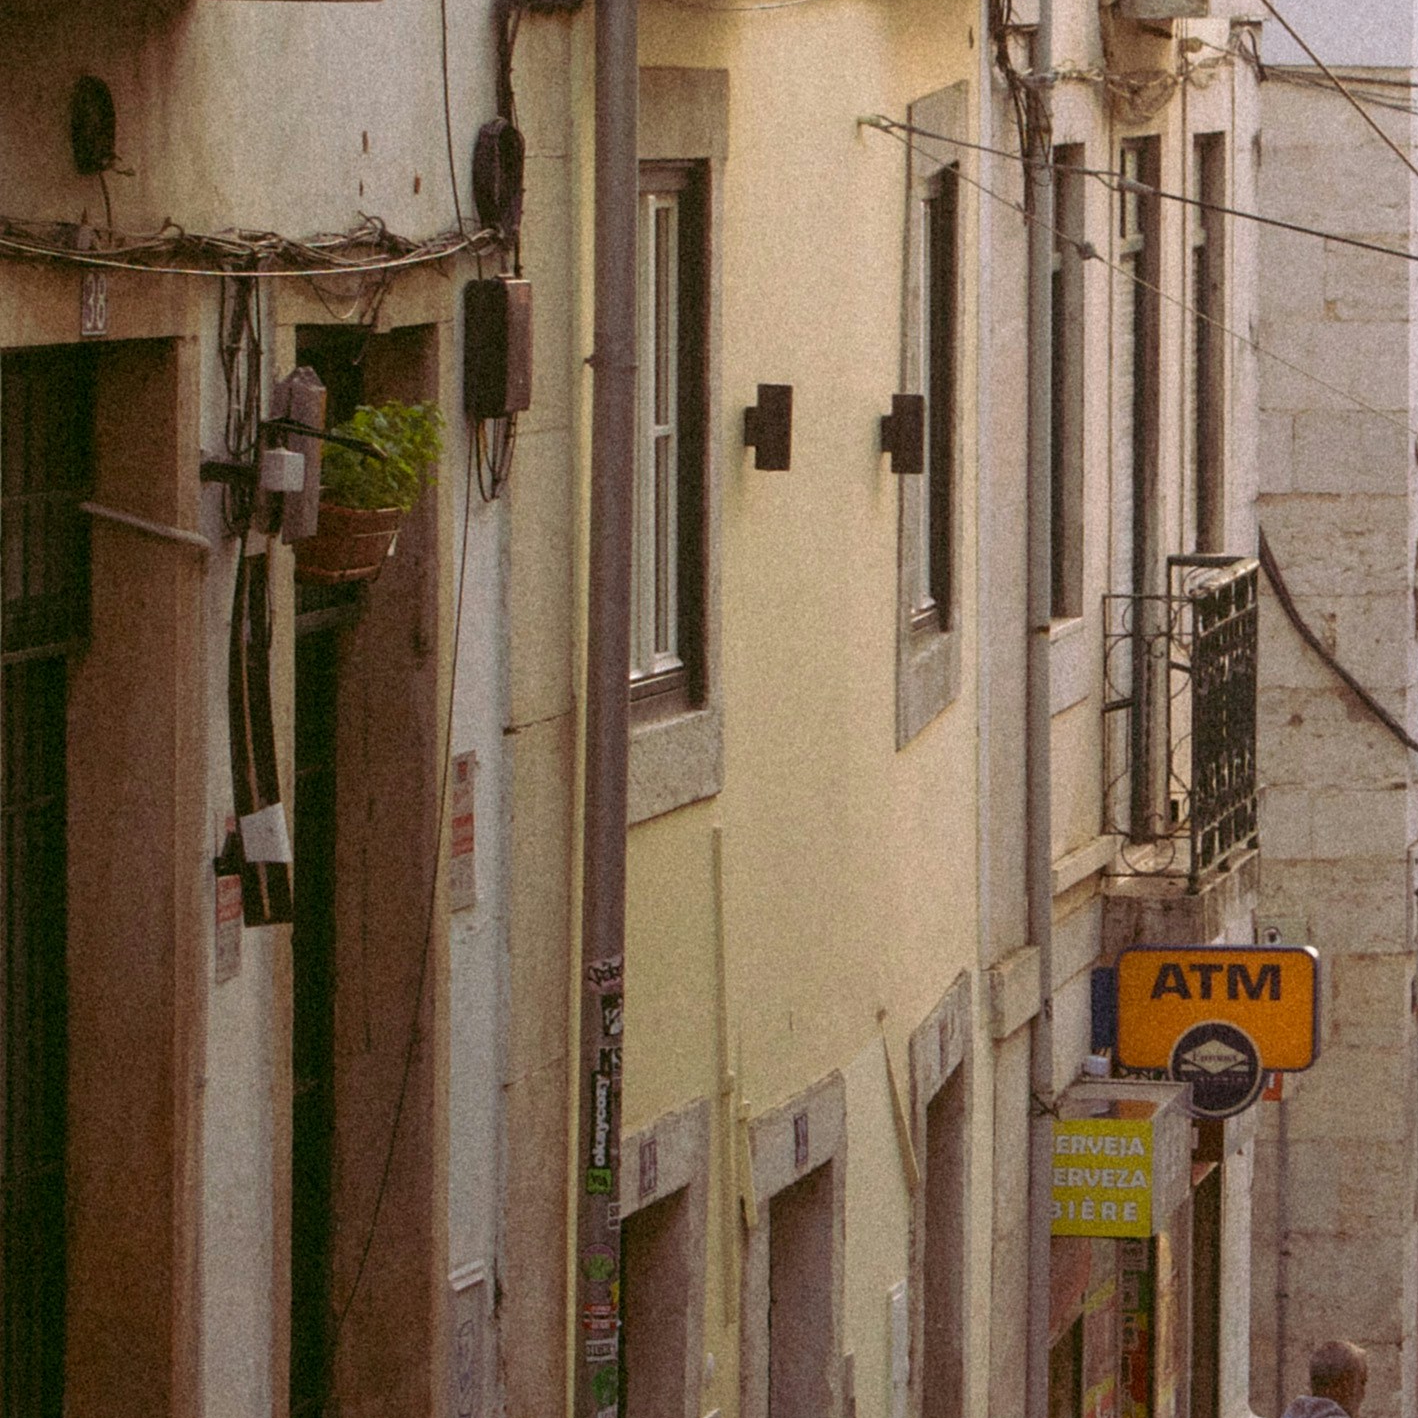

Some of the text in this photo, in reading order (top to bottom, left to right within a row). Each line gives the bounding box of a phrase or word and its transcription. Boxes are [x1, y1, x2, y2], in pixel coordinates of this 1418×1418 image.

[86, 273, 106, 329] 38
[1150, 962, 1282, 1001] ATM
[1052, 1135, 1145, 1157] ERVEJA
[1052, 1167, 1147, 1189] ERVEZA
